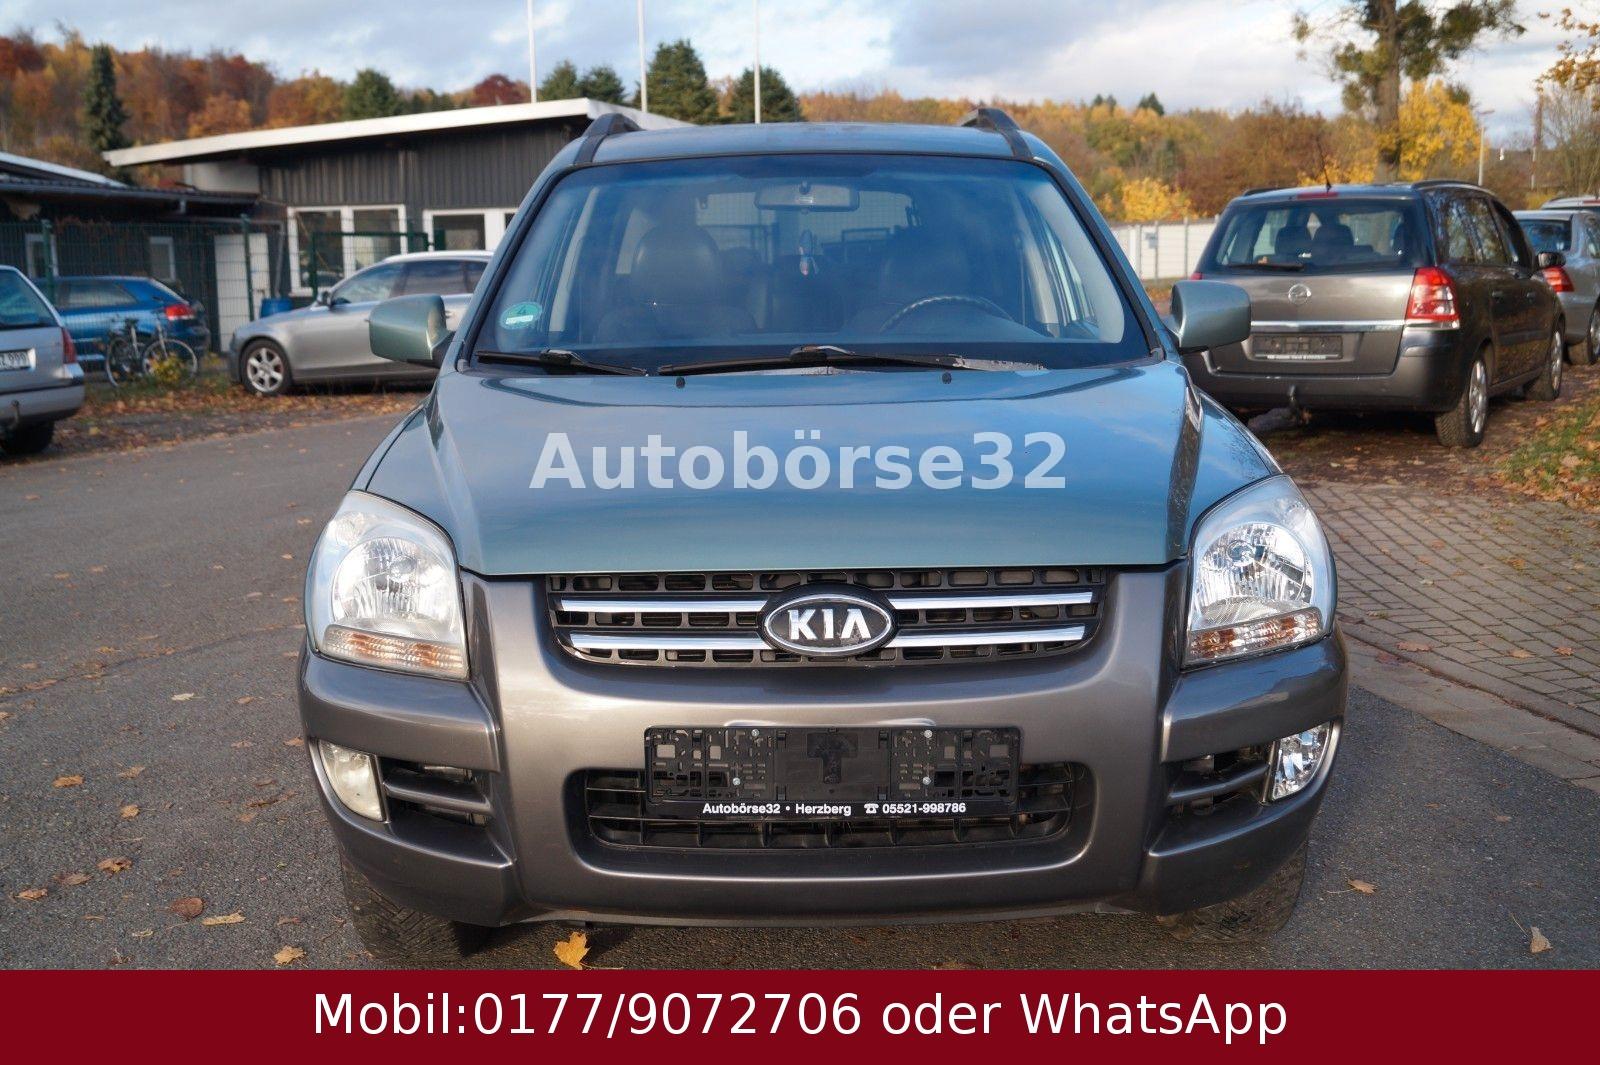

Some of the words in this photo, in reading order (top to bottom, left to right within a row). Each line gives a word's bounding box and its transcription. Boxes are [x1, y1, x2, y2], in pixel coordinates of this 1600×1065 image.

[788, 608, 872, 640] KIA
[702, 803, 781, 814] Autobörse32
[795, 803, 852, 816] Herzberg
[882, 803, 967, 814] 05521-998786
